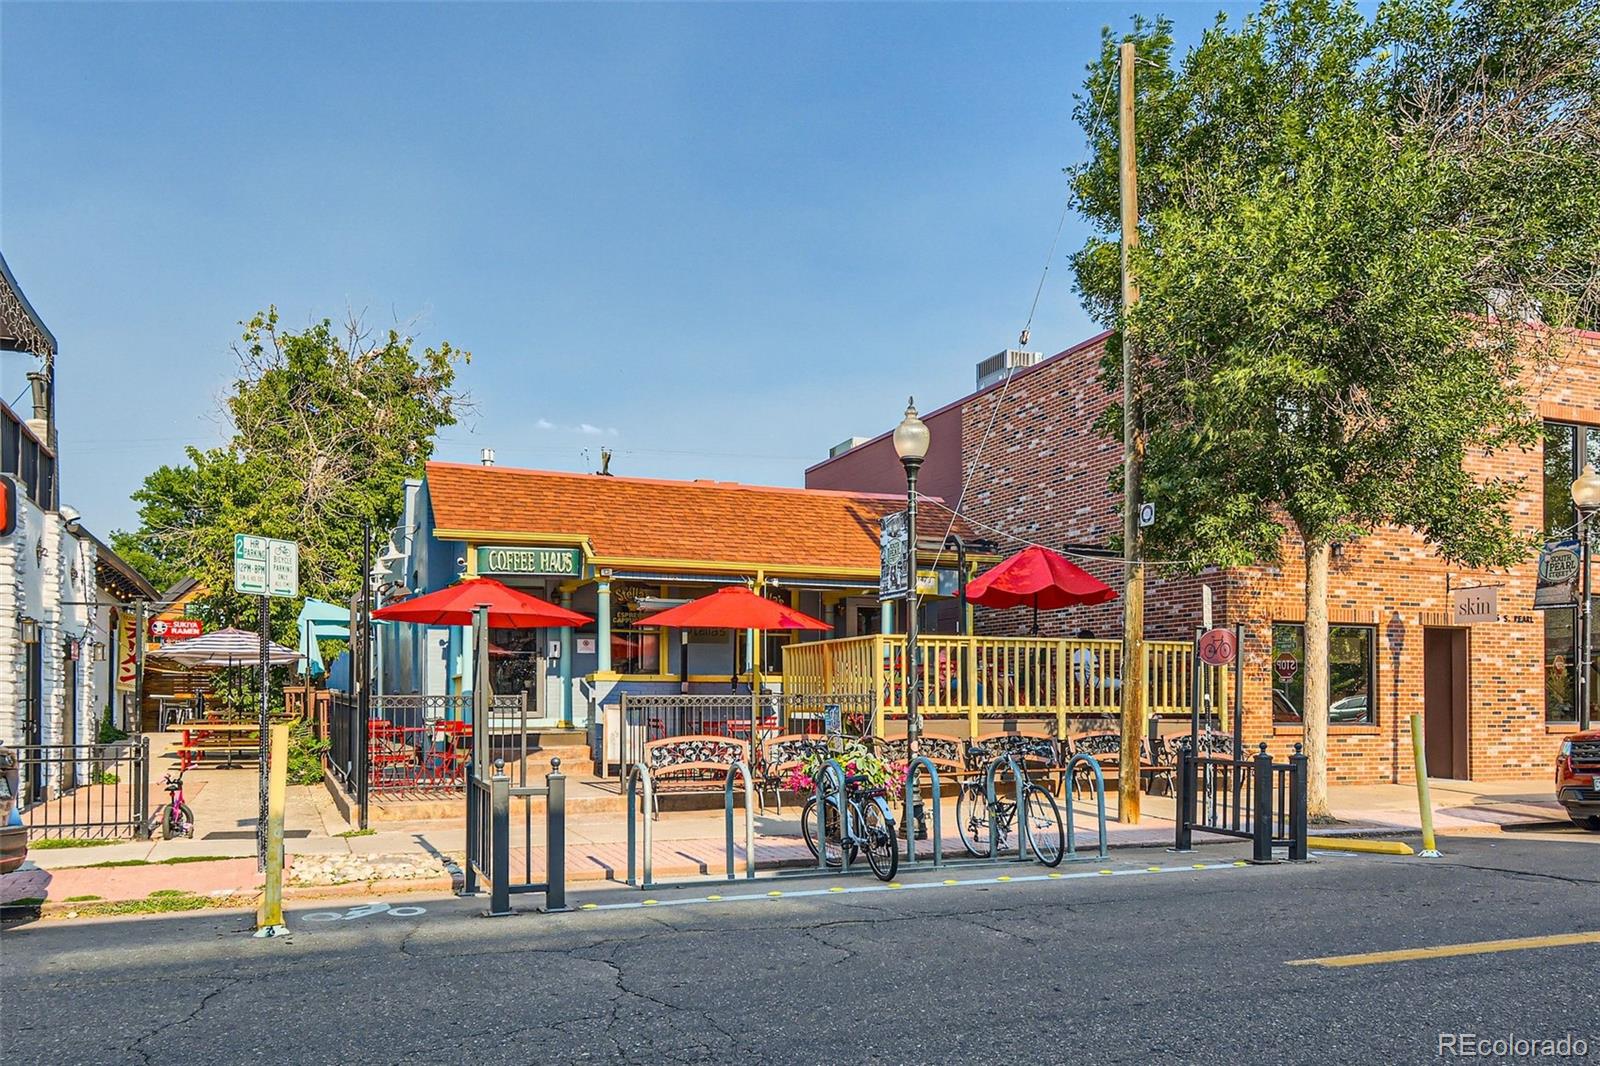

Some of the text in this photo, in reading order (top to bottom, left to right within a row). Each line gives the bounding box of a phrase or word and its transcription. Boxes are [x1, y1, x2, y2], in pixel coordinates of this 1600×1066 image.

[236, 539, 243, 554] 2
[250, 540, 260, 549] HR
[244, 548, 265, 560] PARKING
[1550, 554, 1572, 562] SOUTH
[273, 556, 292, 565] BICYCLE
[489, 550, 573, 572] COFFEE HAUS
[273, 564, 293, 573] PARKING
[1549, 560, 1576, 572] PEARL
[1548, 570, 1570, 578] STREET
[615, 586, 649, 602] Stella
[1459, 597, 1490, 616] skin
[1514, 615, 1534, 624] PEARL
